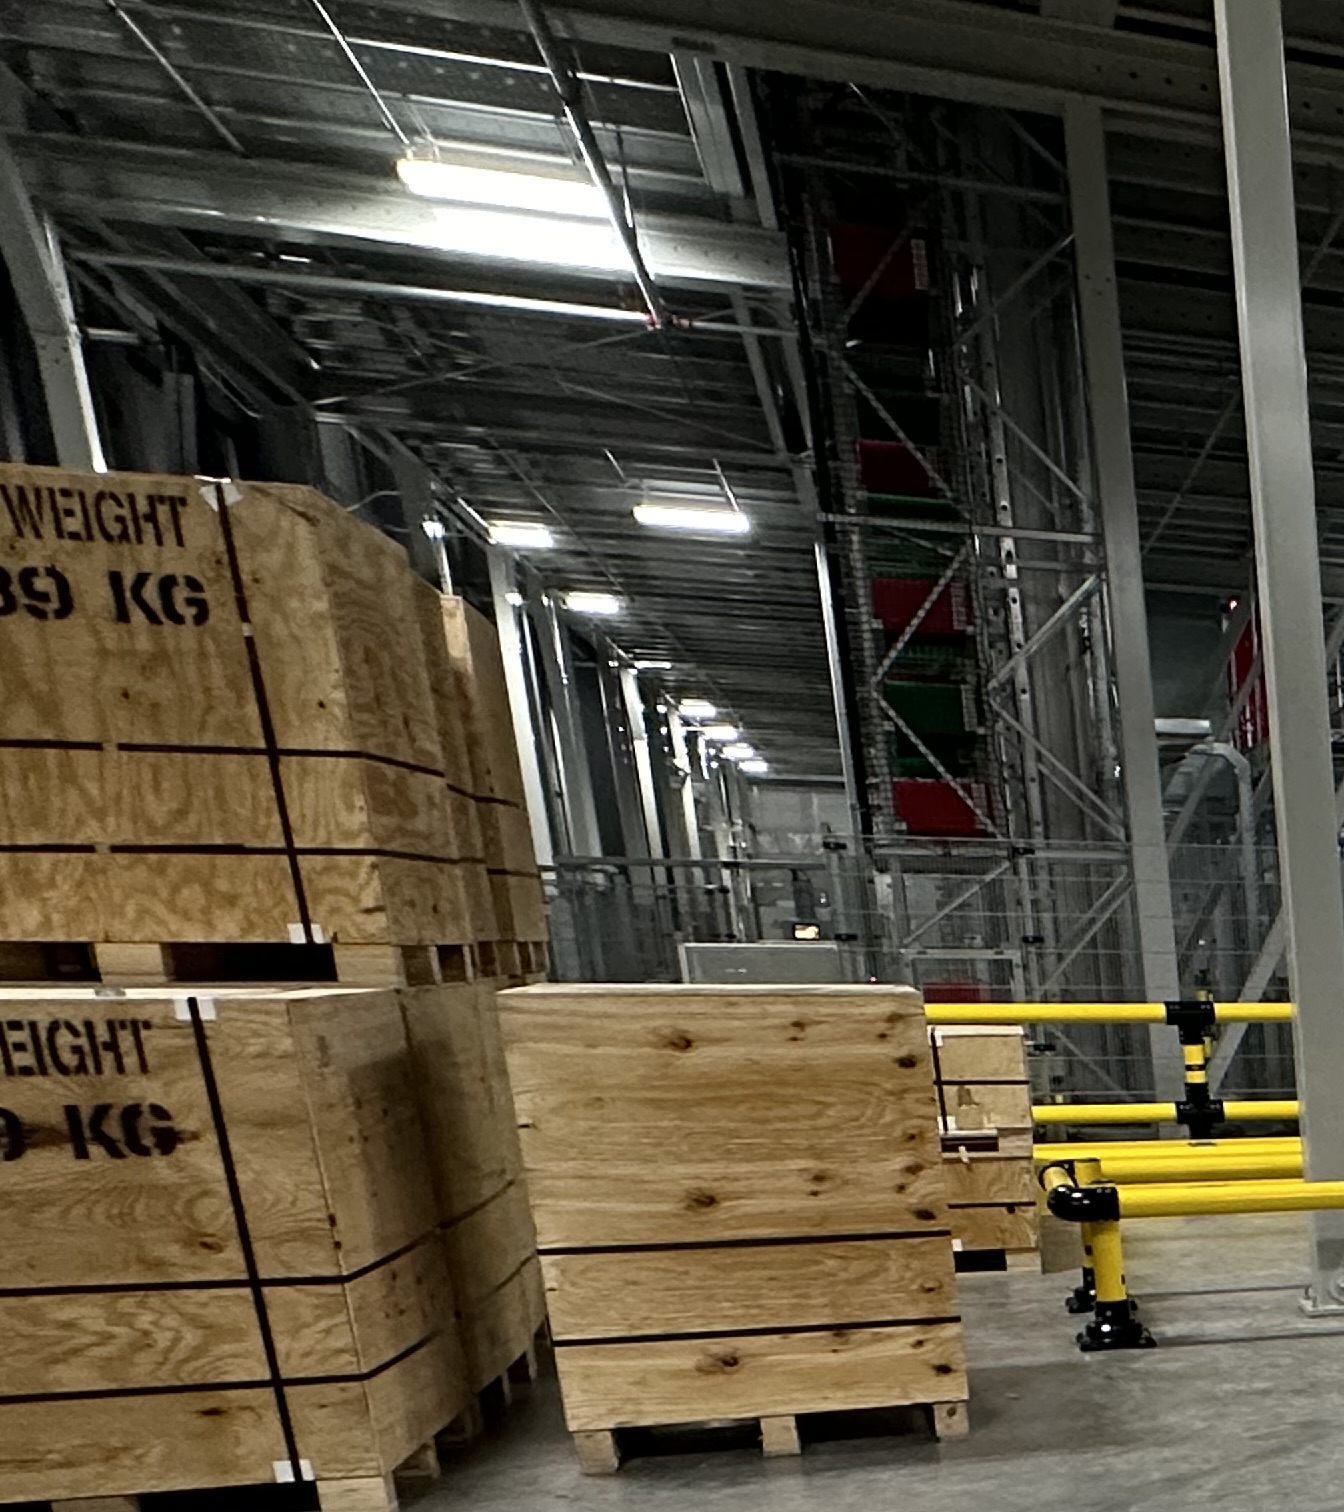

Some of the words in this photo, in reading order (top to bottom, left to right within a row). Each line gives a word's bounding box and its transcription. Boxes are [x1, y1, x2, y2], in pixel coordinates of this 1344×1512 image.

[0, 484, 188, 547] WEIGHT
[108, 571, 210, 625] KG
[0, 1020, 152, 1076] EIGHT
[63, 1103, 174, 1160] KG
